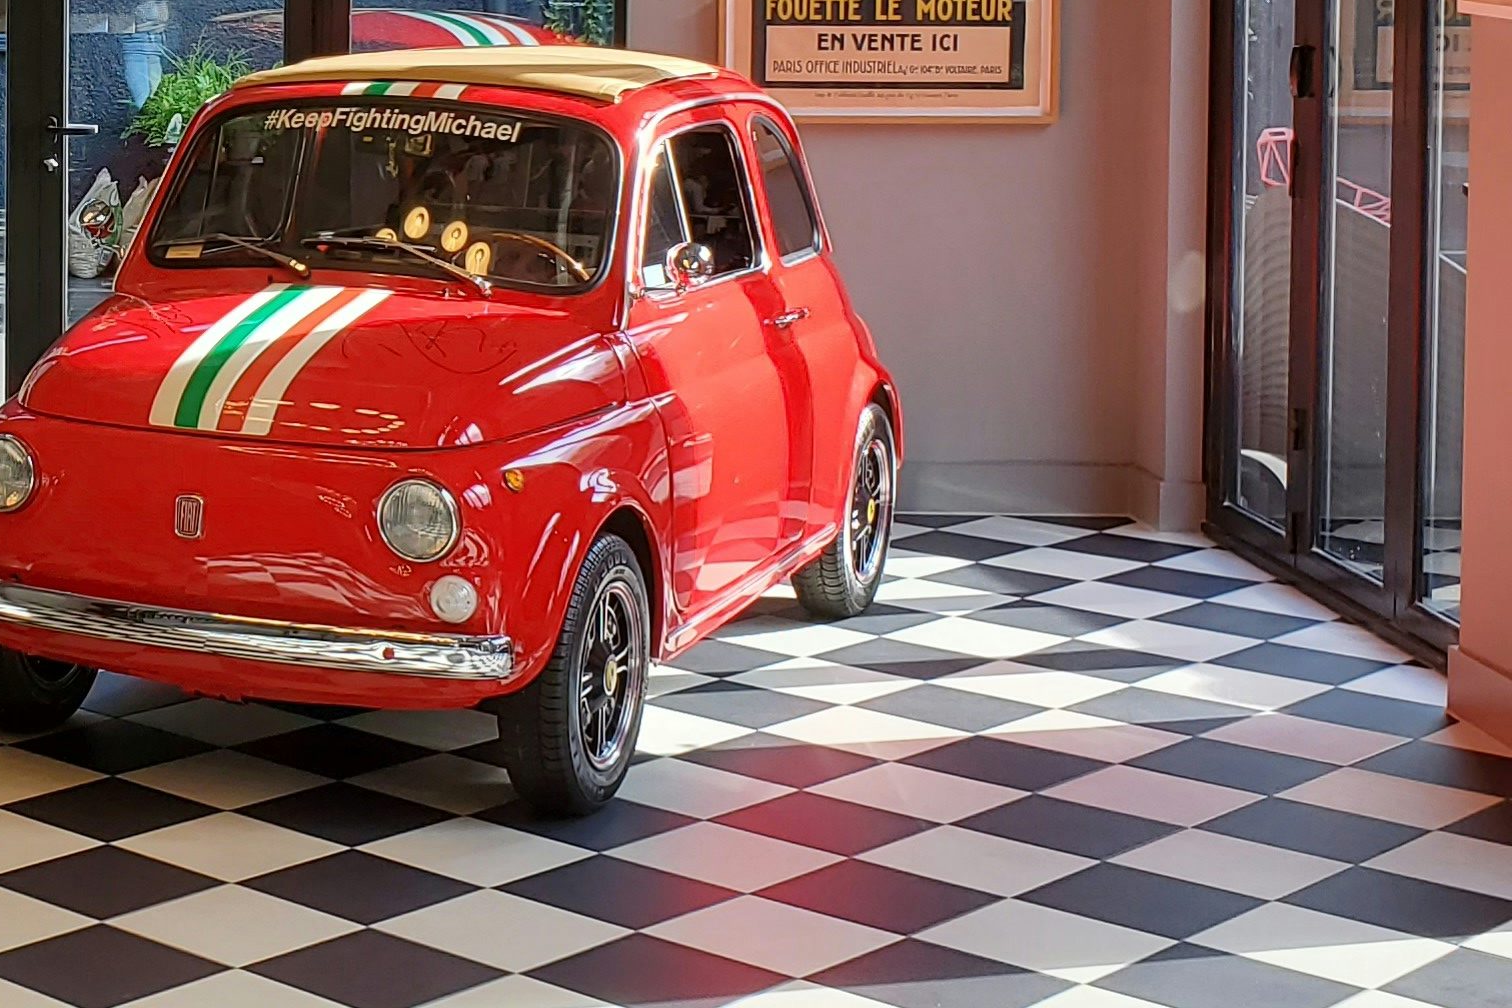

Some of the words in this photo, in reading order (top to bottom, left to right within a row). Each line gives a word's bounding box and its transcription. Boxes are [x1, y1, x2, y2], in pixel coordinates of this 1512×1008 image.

[817, 33, 845, 52] EN
[855, 33, 924, 52] VENTE
[931, 33, 959, 52] ICI
[773, 60, 802, 74] PARIS
[805, 60, 840, 74] OFFICE
[842, 59, 899, 74] INDUSTRIEL
[980, 65, 1003, 75] PARIS
[264, 107, 521, 143] #KeepFightingMichael
[180, 501, 197, 532] FIAT
